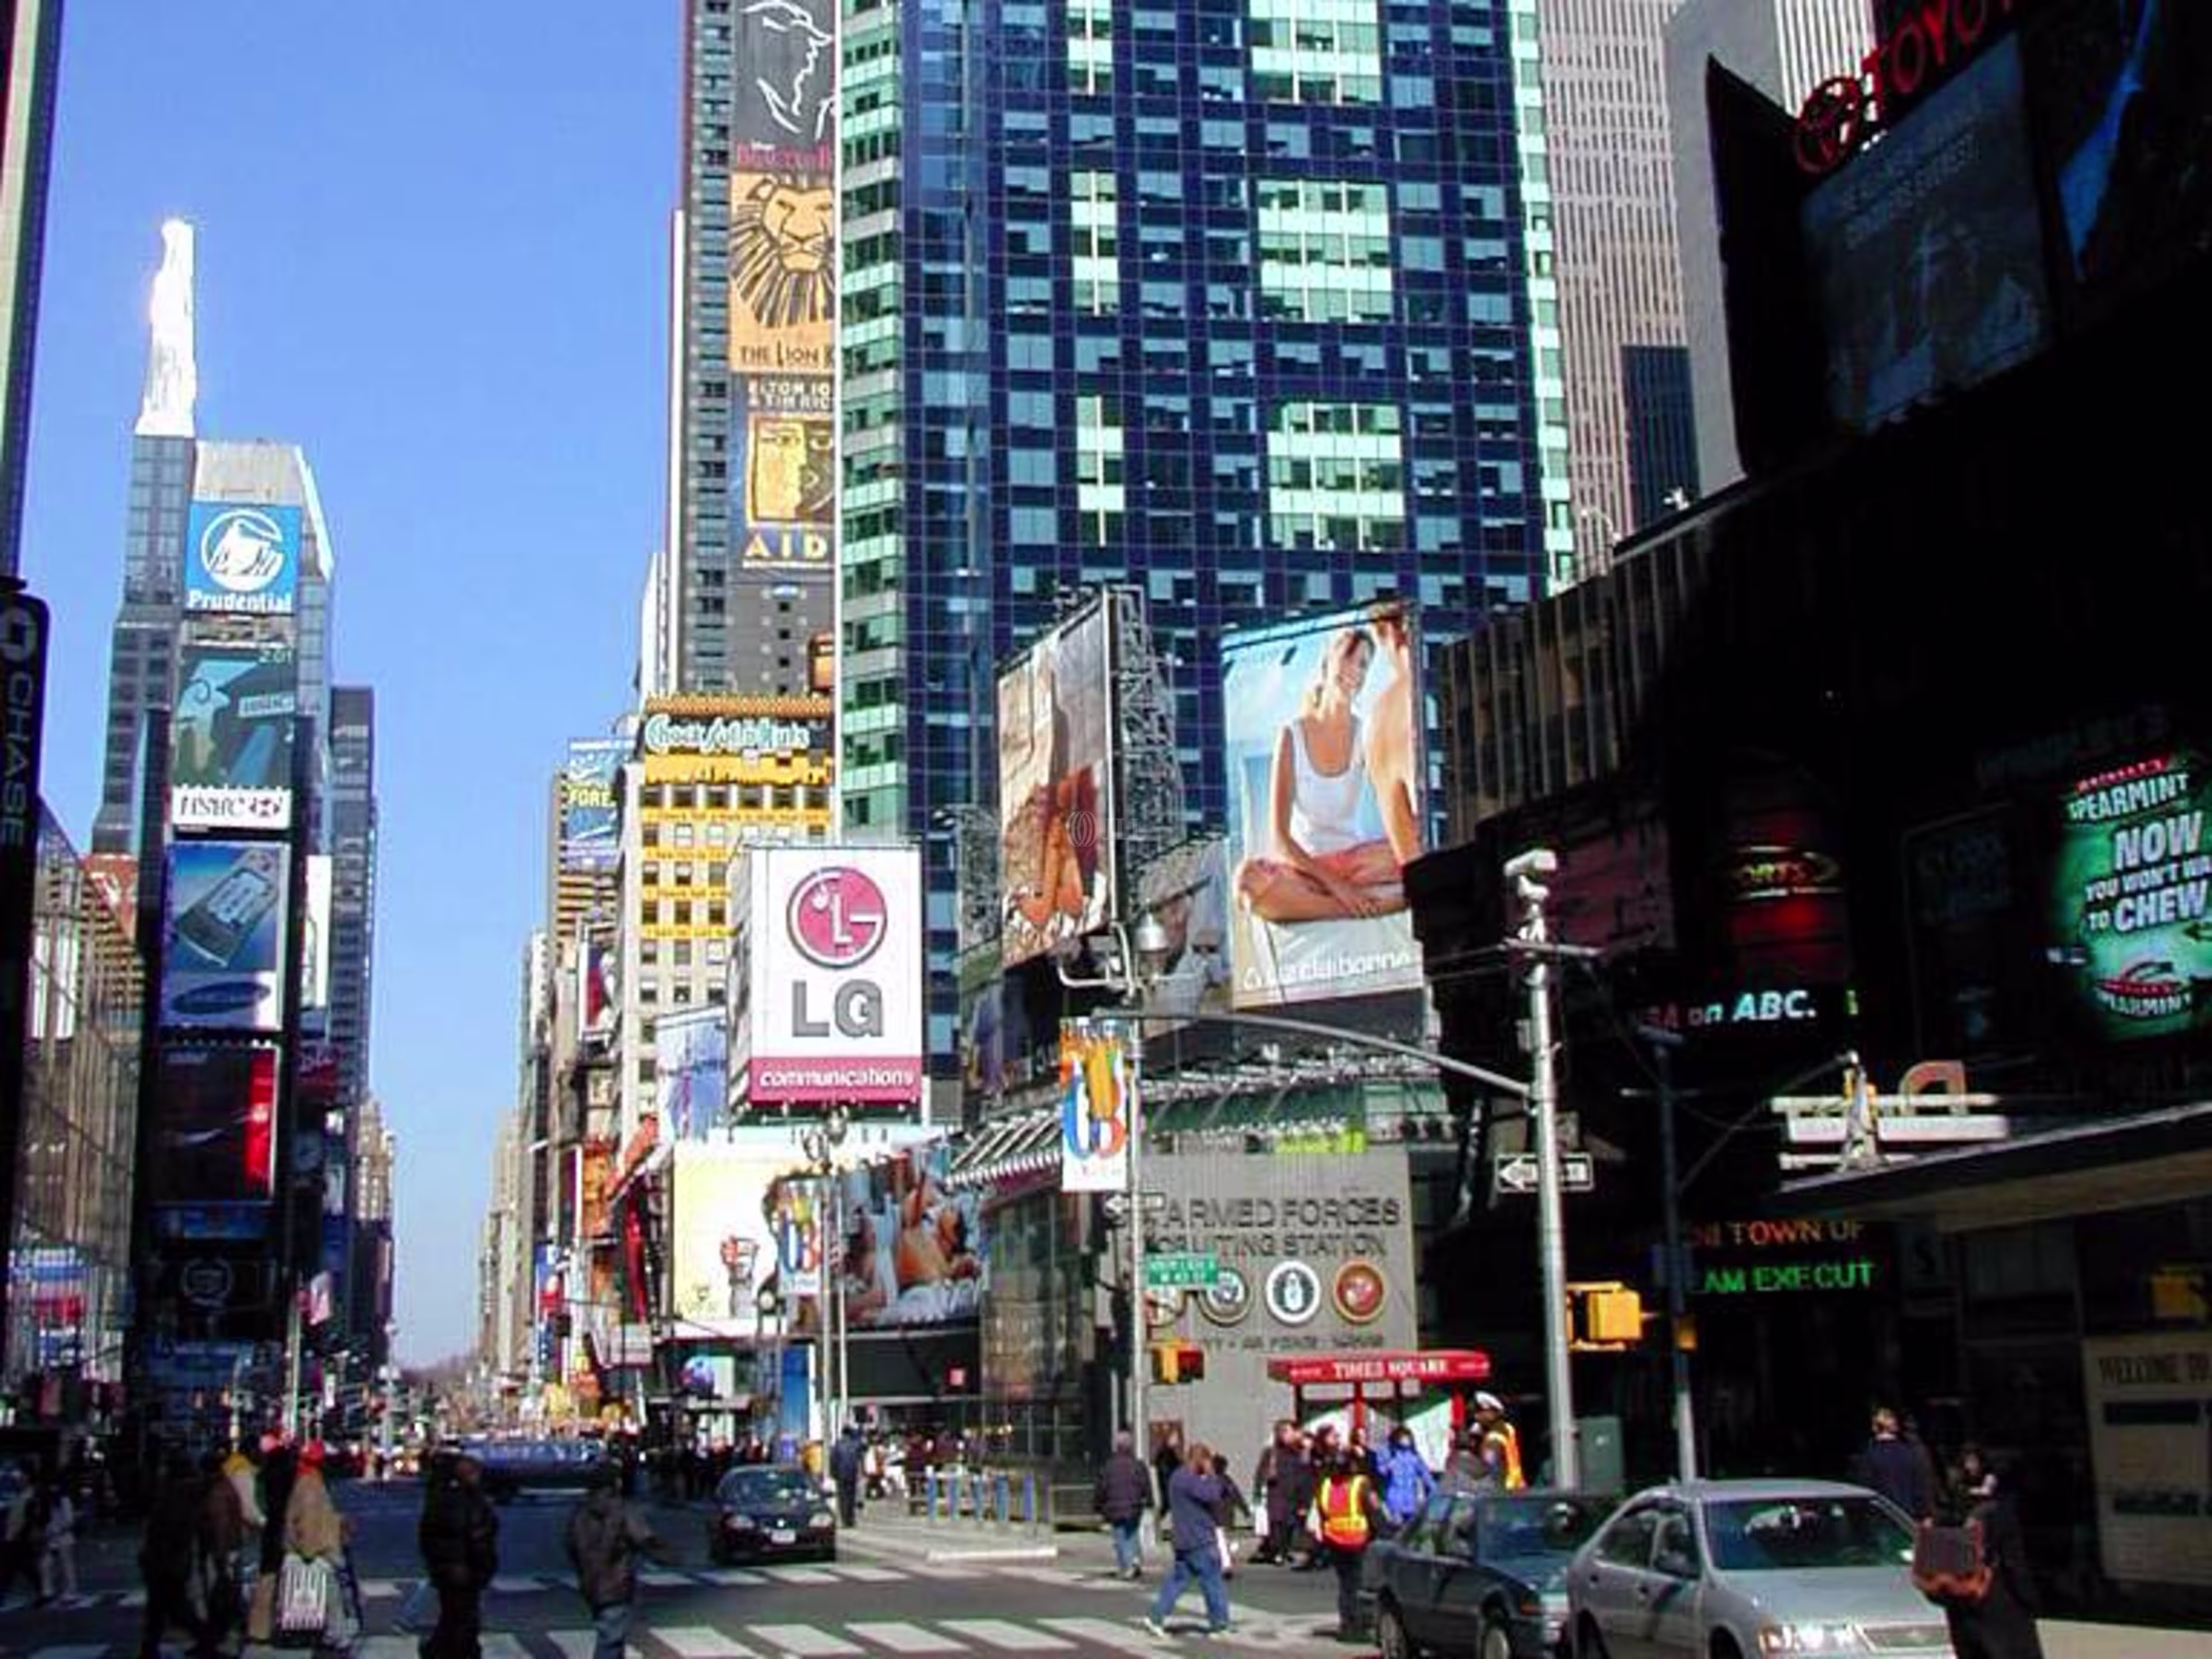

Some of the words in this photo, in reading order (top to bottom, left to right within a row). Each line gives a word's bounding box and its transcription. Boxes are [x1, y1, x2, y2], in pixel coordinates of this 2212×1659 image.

[1862, 0, 2016, 122] TOYO
[741, 345, 768, 364] THE
[778, 339, 819, 367] LION
[187, 589, 293, 612] Prudential
[2, 671, 33, 849] CHASE
[180, 796, 246, 817] HSBC
[2067, 772, 2190, 820] SPEARMINT
[2115, 810, 2203, 871] NOW
[2085, 877, 2120, 902] YOU
[2122, 863, 2180, 892] WON'T
[2089, 910, 2111, 931] TO
[2115, 879, 2207, 932] CHEW
[791, 979, 884, 1038] LG
[1732, 989, 1817, 1022] ABC.
[759, 1066, 915, 1089] communications
[1162, 1198, 1276, 1228] ARMED
[1282, 1197, 1400, 1228] FORCES
[1284, 1233, 1387, 1256] STATION
[1727, 1218, 1821, 1246] TOWN
[1332, 1360, 1384, 1379] TIMES
